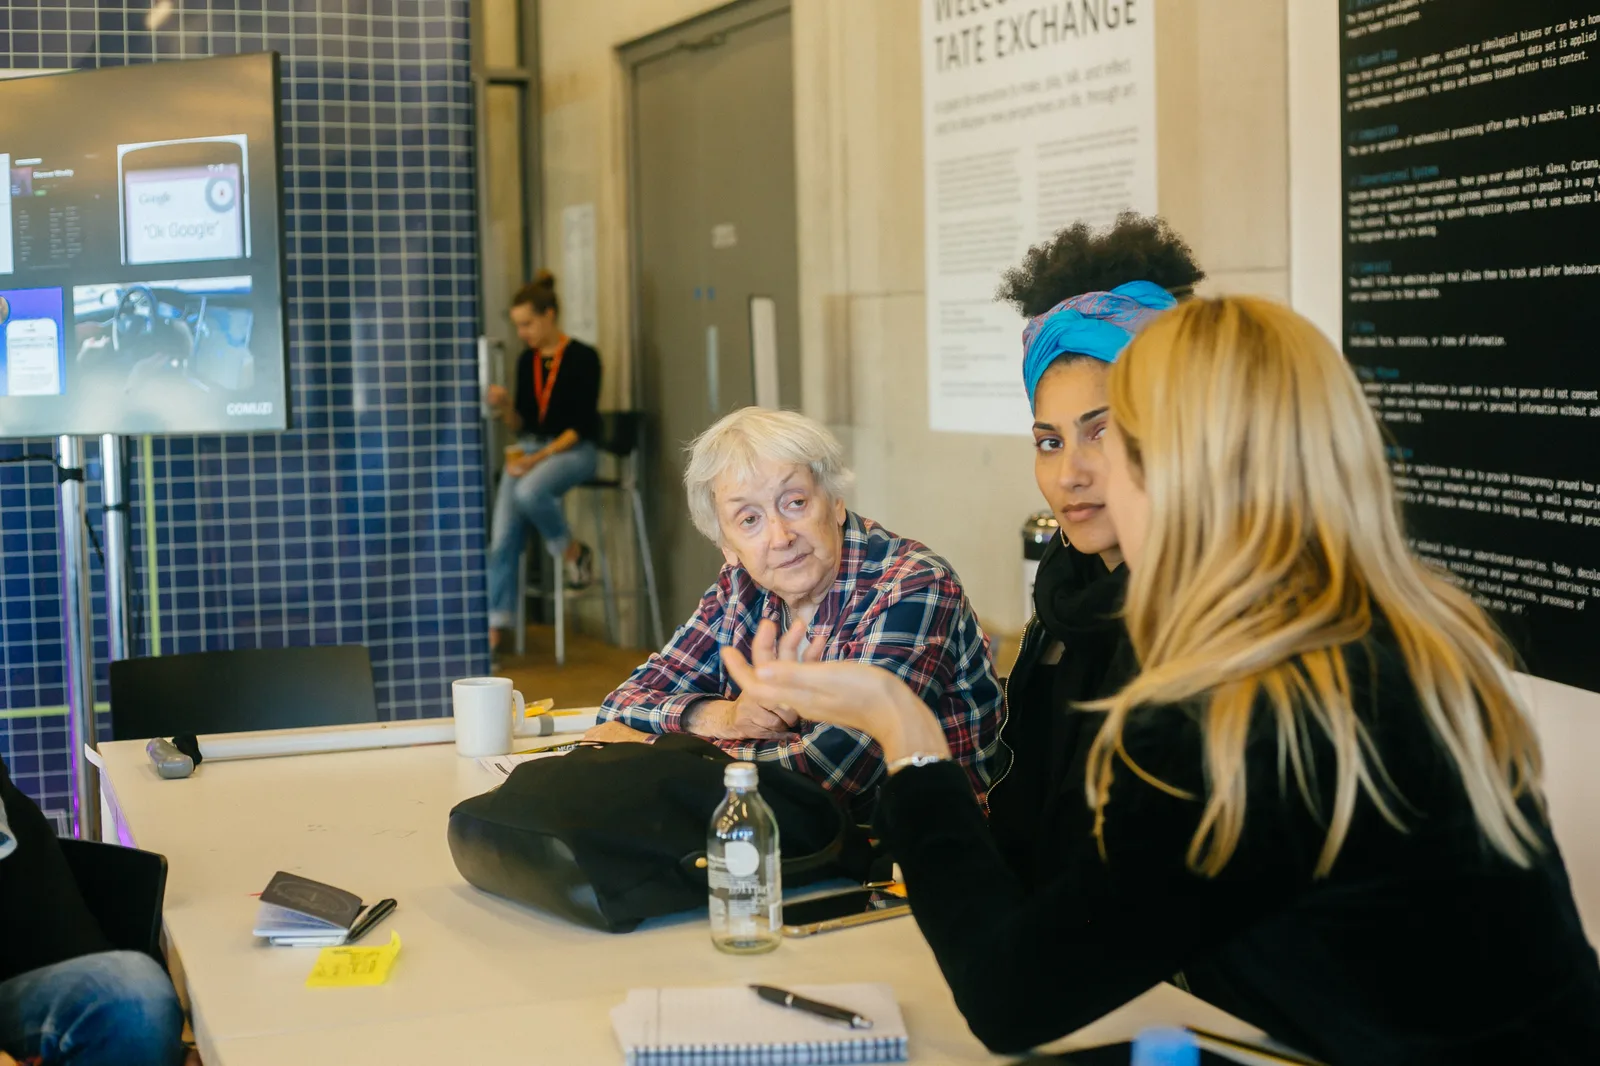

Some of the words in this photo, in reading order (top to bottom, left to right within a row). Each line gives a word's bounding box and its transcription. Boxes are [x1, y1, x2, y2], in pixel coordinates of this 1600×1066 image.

[934, 25, 985, 74] TATE
[995, 0, 1136, 58] EXCHANGE
[1520, 28, 1542, 41] biases
[1545, 26, 1552, 35] or
[1555, 22, 1567, 32] can
[1569, 19, 1578, 29] be
[1581, 18, 1586, 26] a
[1485, 56, 1490, 66] a
[1527, 44, 1543, 55] data
[1545, 40, 1556, 51] set
[1560, 37, 1567, 48] is
[1570, 30, 1597, 46] applied
[1495, 65, 1516, 78] biased
[1517, 61, 1539, 73] within
[1541, 56, 1556, 68] this
[1559, 51, 1589, 64] context.
[1485, 120, 1504, 131] often
[1505, 118, 1520, 128] done
[1521, 115, 1530, 126] by
[1531, 115, 1537, 124] a
[1538, 110, 1568, 122] machine,
[1571, 105, 1587, 116] like
[1589, 104, 1594, 113] a
[1489, 172, 1503, 181] ever
[1505, 168, 1524, 180] asked
[1525, 166, 1544, 177] Siri,
[1546, 163, 1569, 174] Alexa,
[1522, 182, 1537, 193] with
[1539, 179, 1562, 192] people
[1564, 179, 1573, 188] in
[1575, 178, 1580, 187] a
[1582, 177, 1595, 187] way
[1505, 200, 1530, 212] systems
[1532, 198, 1547, 208] that
[1548, 197, 1561, 206] use
[1563, 193, 1591, 204] machine
[1499, 269, 1508, 279] to
[1508, 268, 1527, 278] track
[1528, 267, 1541, 277] and
[1542, 264, 1562, 276] infer
[1502, 386, 1517, 396] that
[1518, 388, 1541, 398] person
[1542, 388, 1555, 398] did
[1556, 389, 1569, 398] not
[1571, 390, 1598, 399] consent
[1519, 403, 1559, 414] information
[1560, 405, 1587, 416] without
[1556, 480, 1580, 490] around
[1581, 481, 1595, 491] how
[1535, 493, 1544, 502] as
[1545, 493, 1561, 504] well
[1563, 497, 1572, 506] as
[1520, 508, 1540, 518] used,
[1541, 510, 1568, 521] stored,
[1569, 514, 1584, 523] and
[1552, 562, 1574, 576] Today,
[1555, 581, 1590, 594] intrinsic
[1540, 594, 1575, 608] processes
[1576, 599, 1586, 610] of
